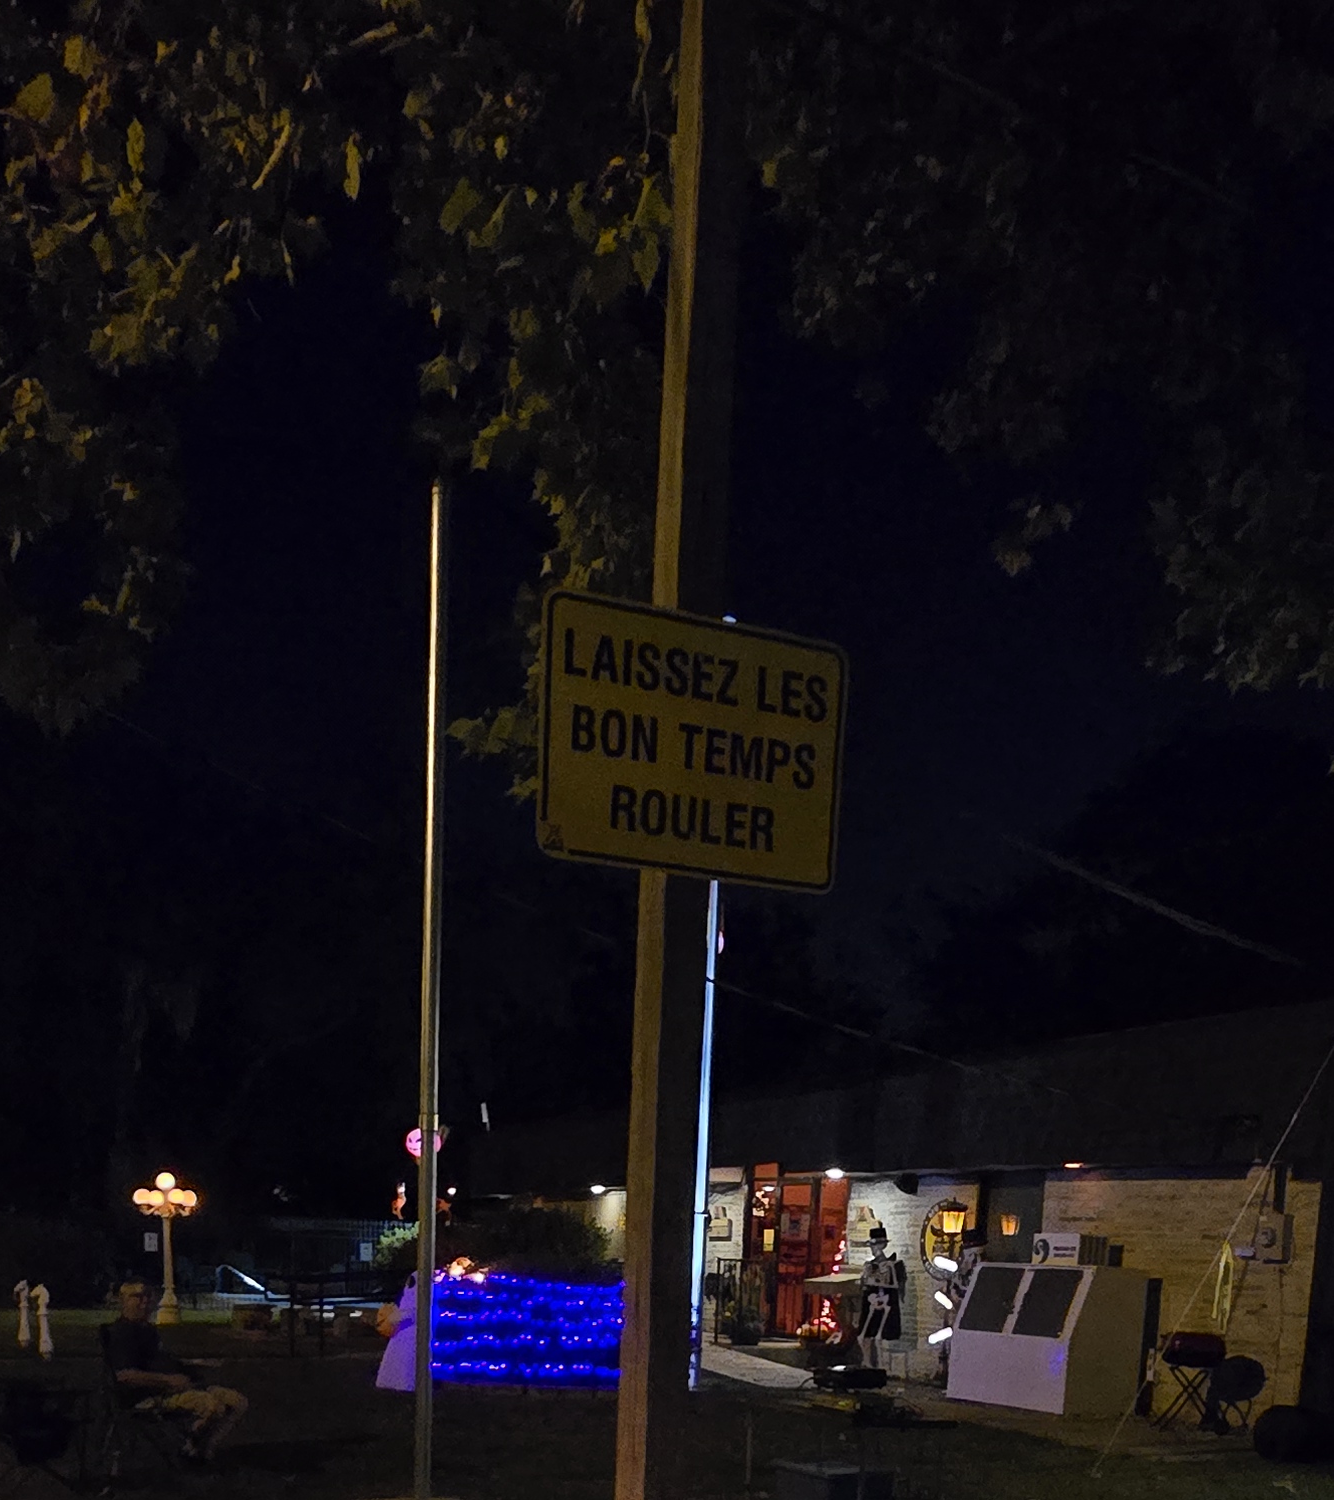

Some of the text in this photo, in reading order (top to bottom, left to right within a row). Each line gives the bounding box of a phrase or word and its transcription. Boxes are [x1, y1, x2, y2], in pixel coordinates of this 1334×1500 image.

[564, 628, 828, 723] LAISSEZ LES
[571, 704, 816, 790] BON TEMPS
[610, 785, 774, 852] ROULER
